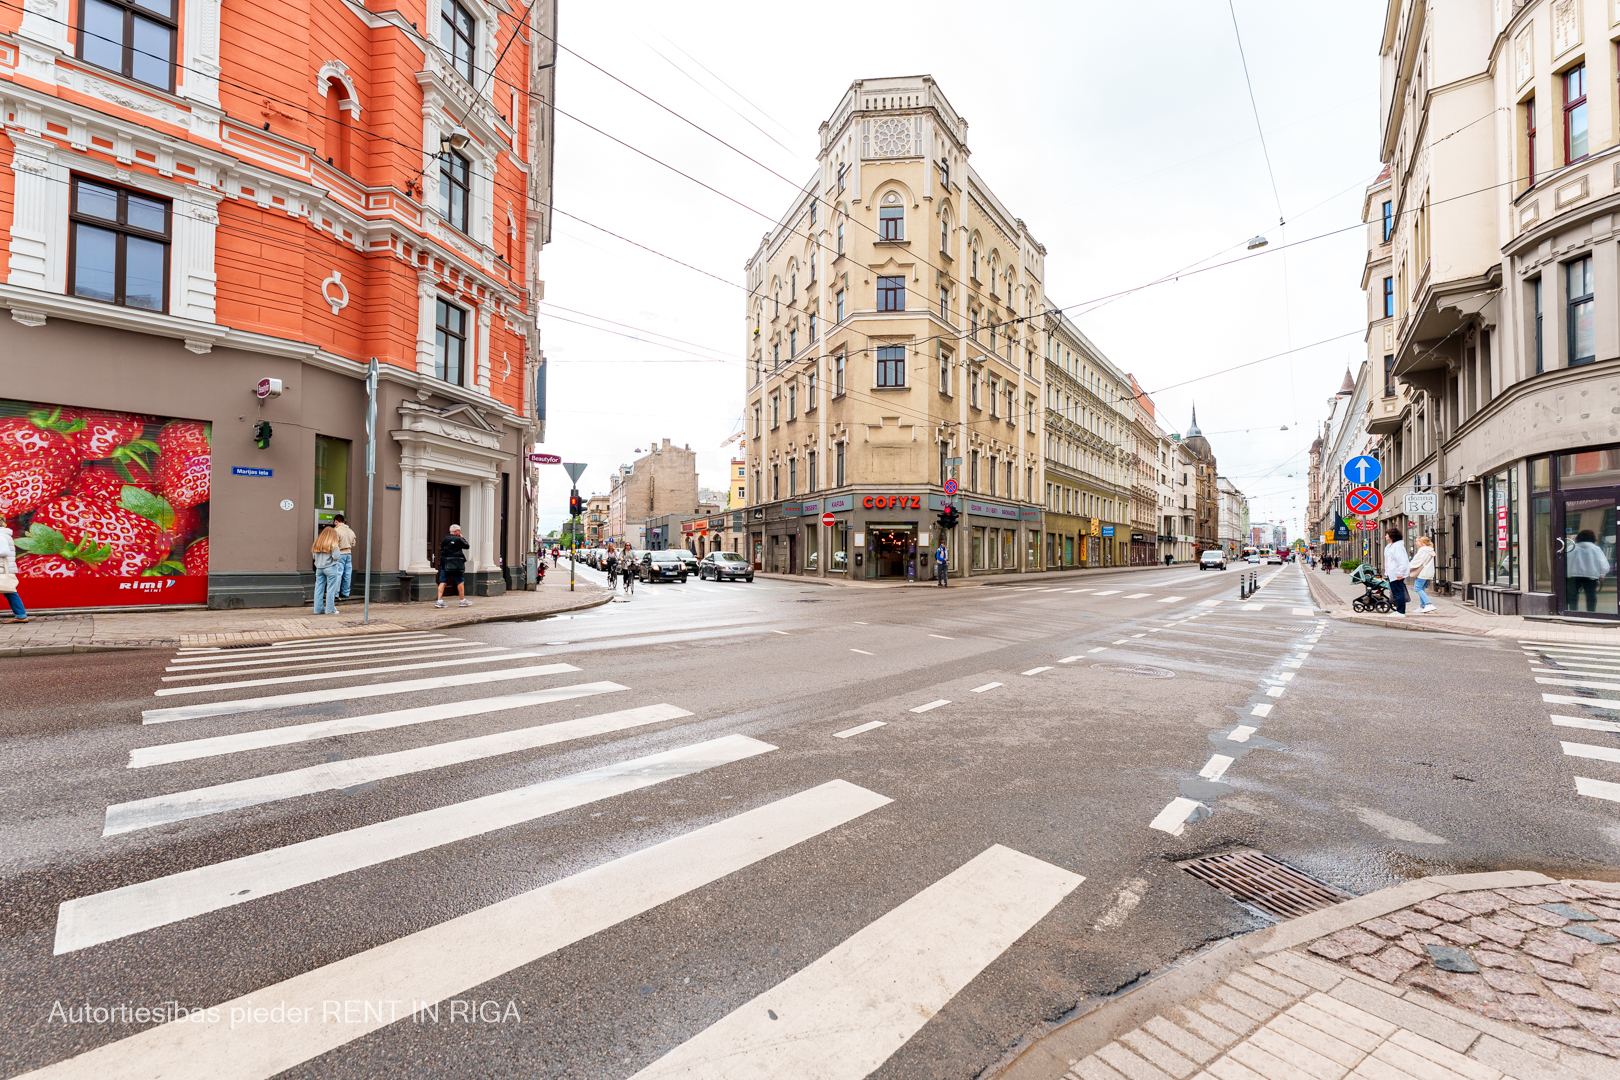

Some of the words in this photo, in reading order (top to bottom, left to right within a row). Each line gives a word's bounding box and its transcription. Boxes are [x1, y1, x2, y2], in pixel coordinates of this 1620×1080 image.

[531, 455, 559, 463] Beautyfor
[236, 468, 257, 476] Marijas
[863, 496, 921, 508] COFYZ
